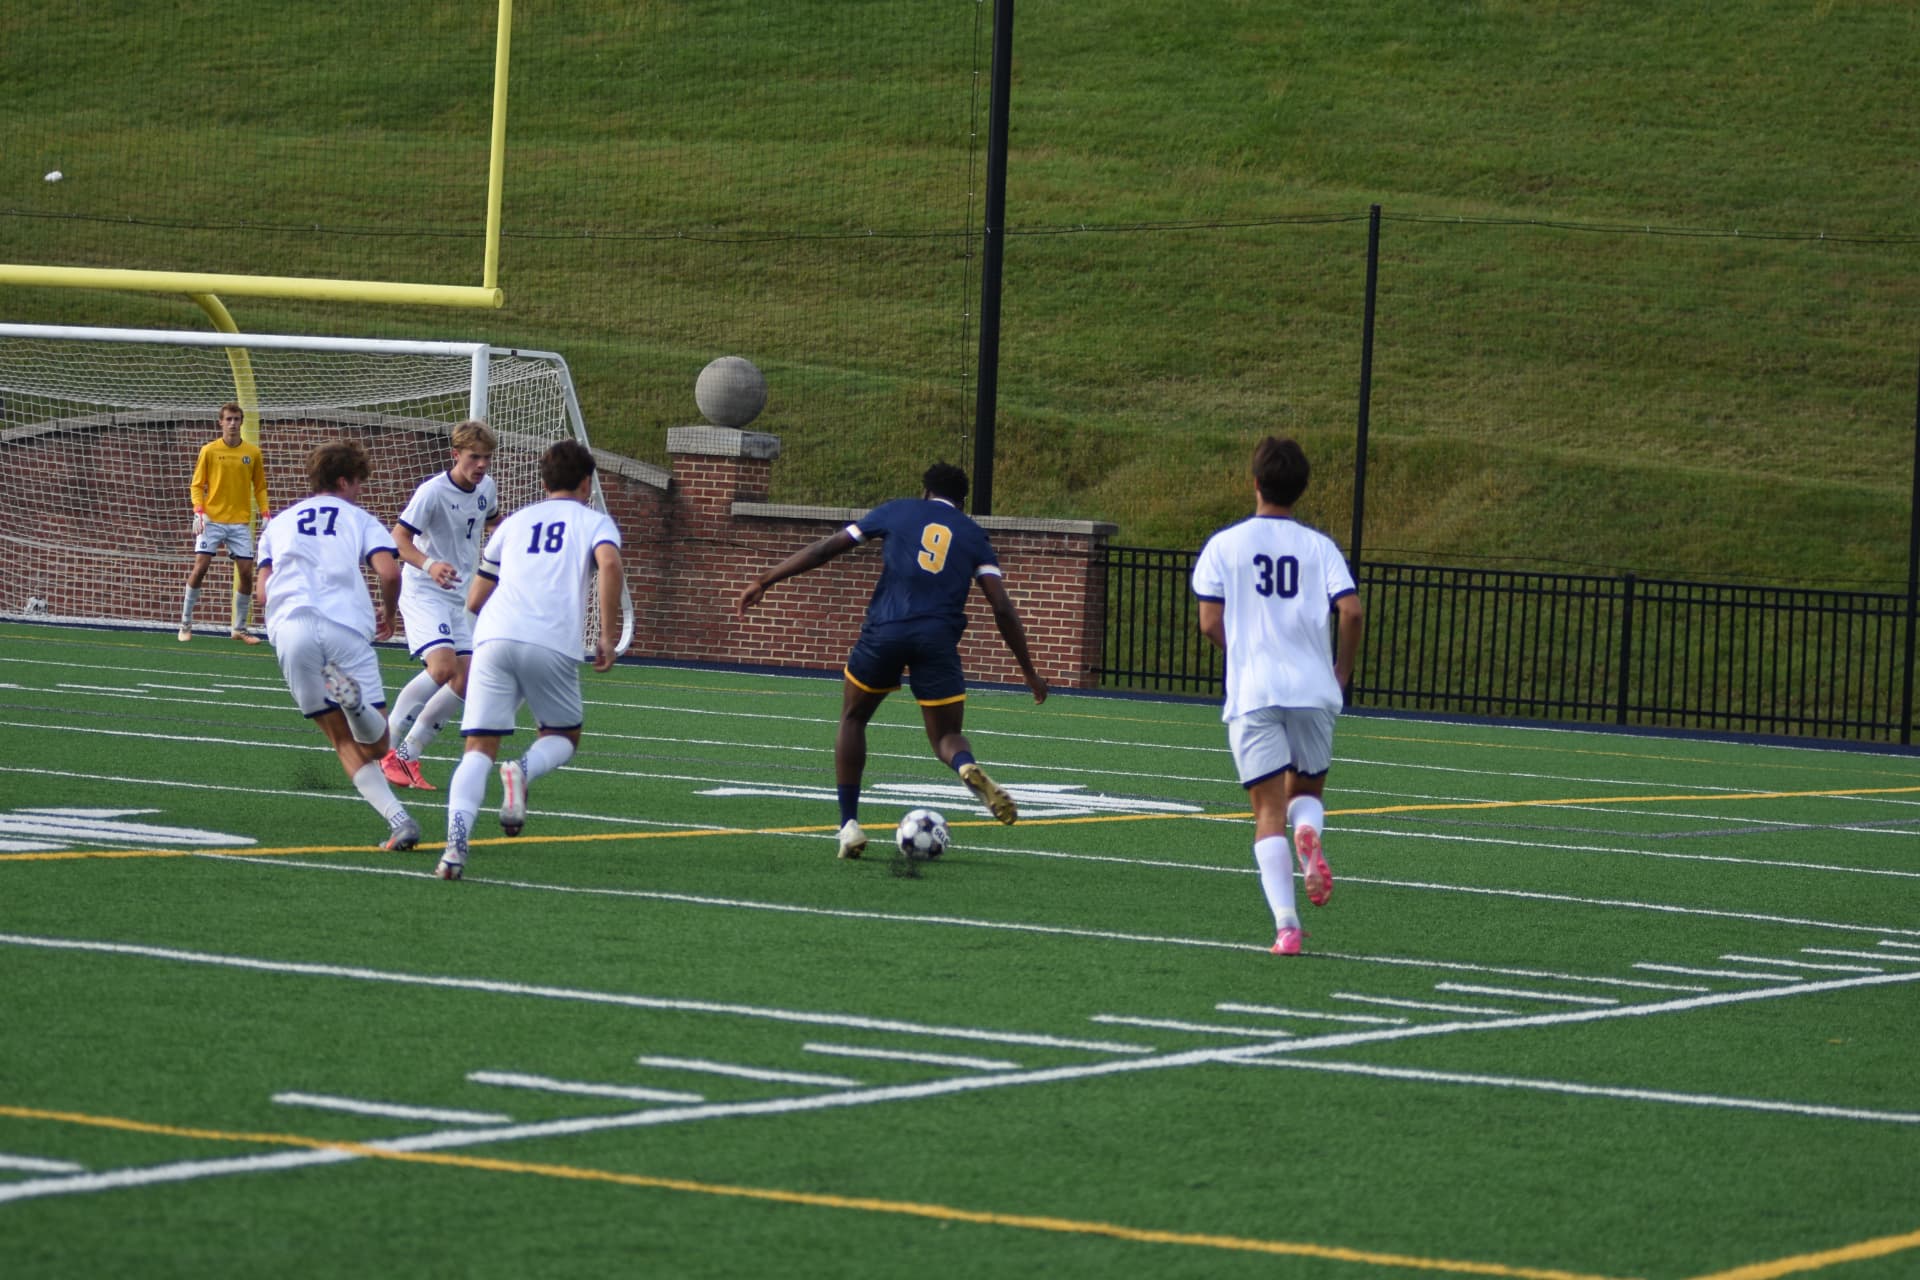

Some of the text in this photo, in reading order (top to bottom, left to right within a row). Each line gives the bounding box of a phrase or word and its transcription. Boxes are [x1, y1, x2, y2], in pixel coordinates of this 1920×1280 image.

[297, 507, 339, 536] 27
[466, 518, 475, 539] 7
[527, 521, 566, 554] 18
[917, 522, 952, 574] 9
[1253, 553, 1299, 599] 30
